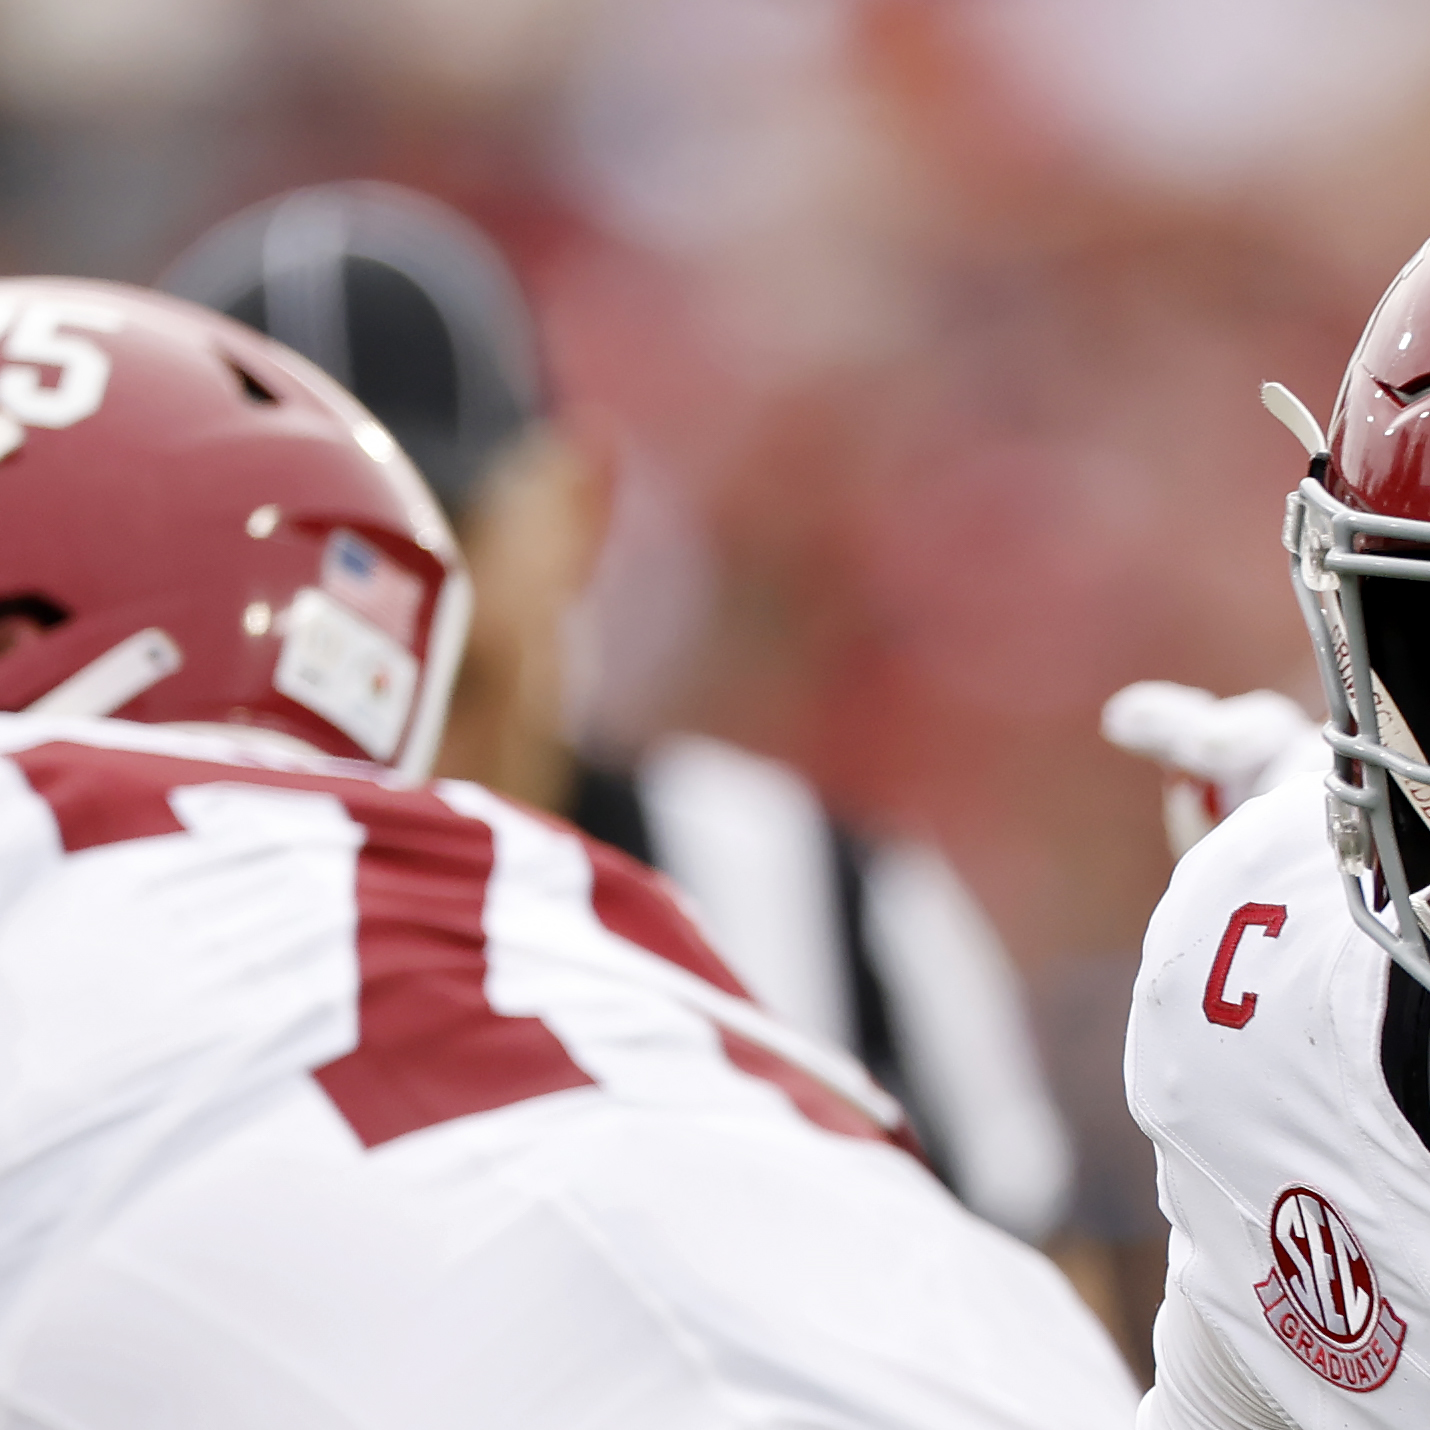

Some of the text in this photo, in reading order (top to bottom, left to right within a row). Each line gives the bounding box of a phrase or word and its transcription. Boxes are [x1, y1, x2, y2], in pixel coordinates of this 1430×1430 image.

[0, 296, 121, 462] 5
[1203, 902, 1286, 1029] C
[1275, 1193, 1371, 1337] SEC
[1279, 1312, 1389, 1386] GRADUATE
